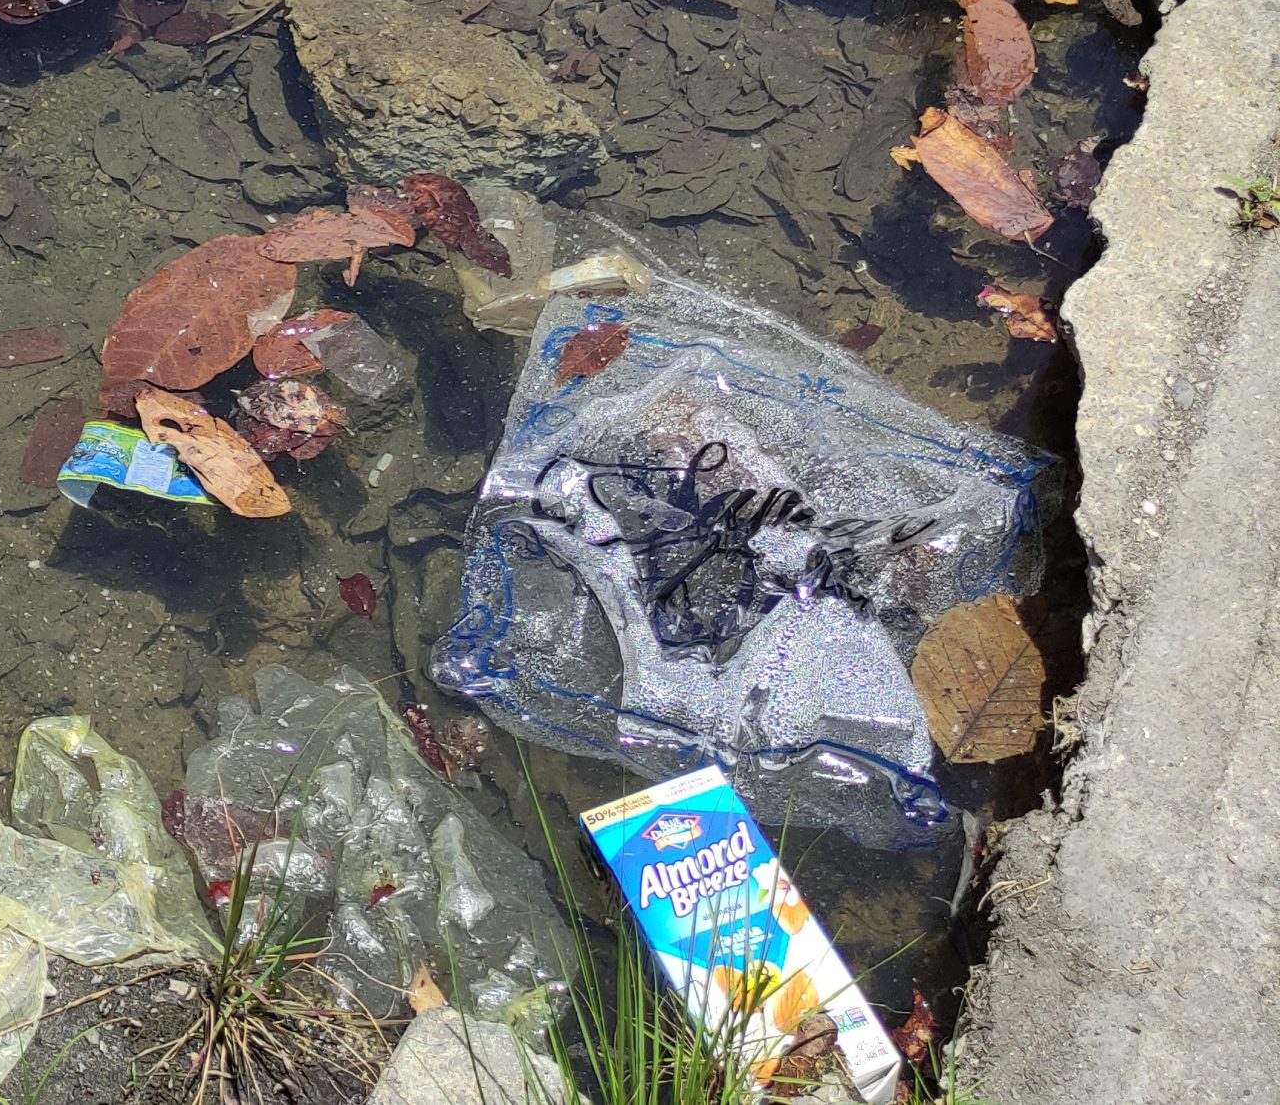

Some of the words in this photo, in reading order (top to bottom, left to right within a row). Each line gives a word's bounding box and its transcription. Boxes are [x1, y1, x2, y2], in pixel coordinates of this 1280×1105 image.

[586, 808, 617, 826] 50%
[658, 817, 680, 830] BLUE
[651, 819, 695, 840] DIAMOND
[640, 822, 756, 909] Almond
[669, 860, 749, 918] Breeze
